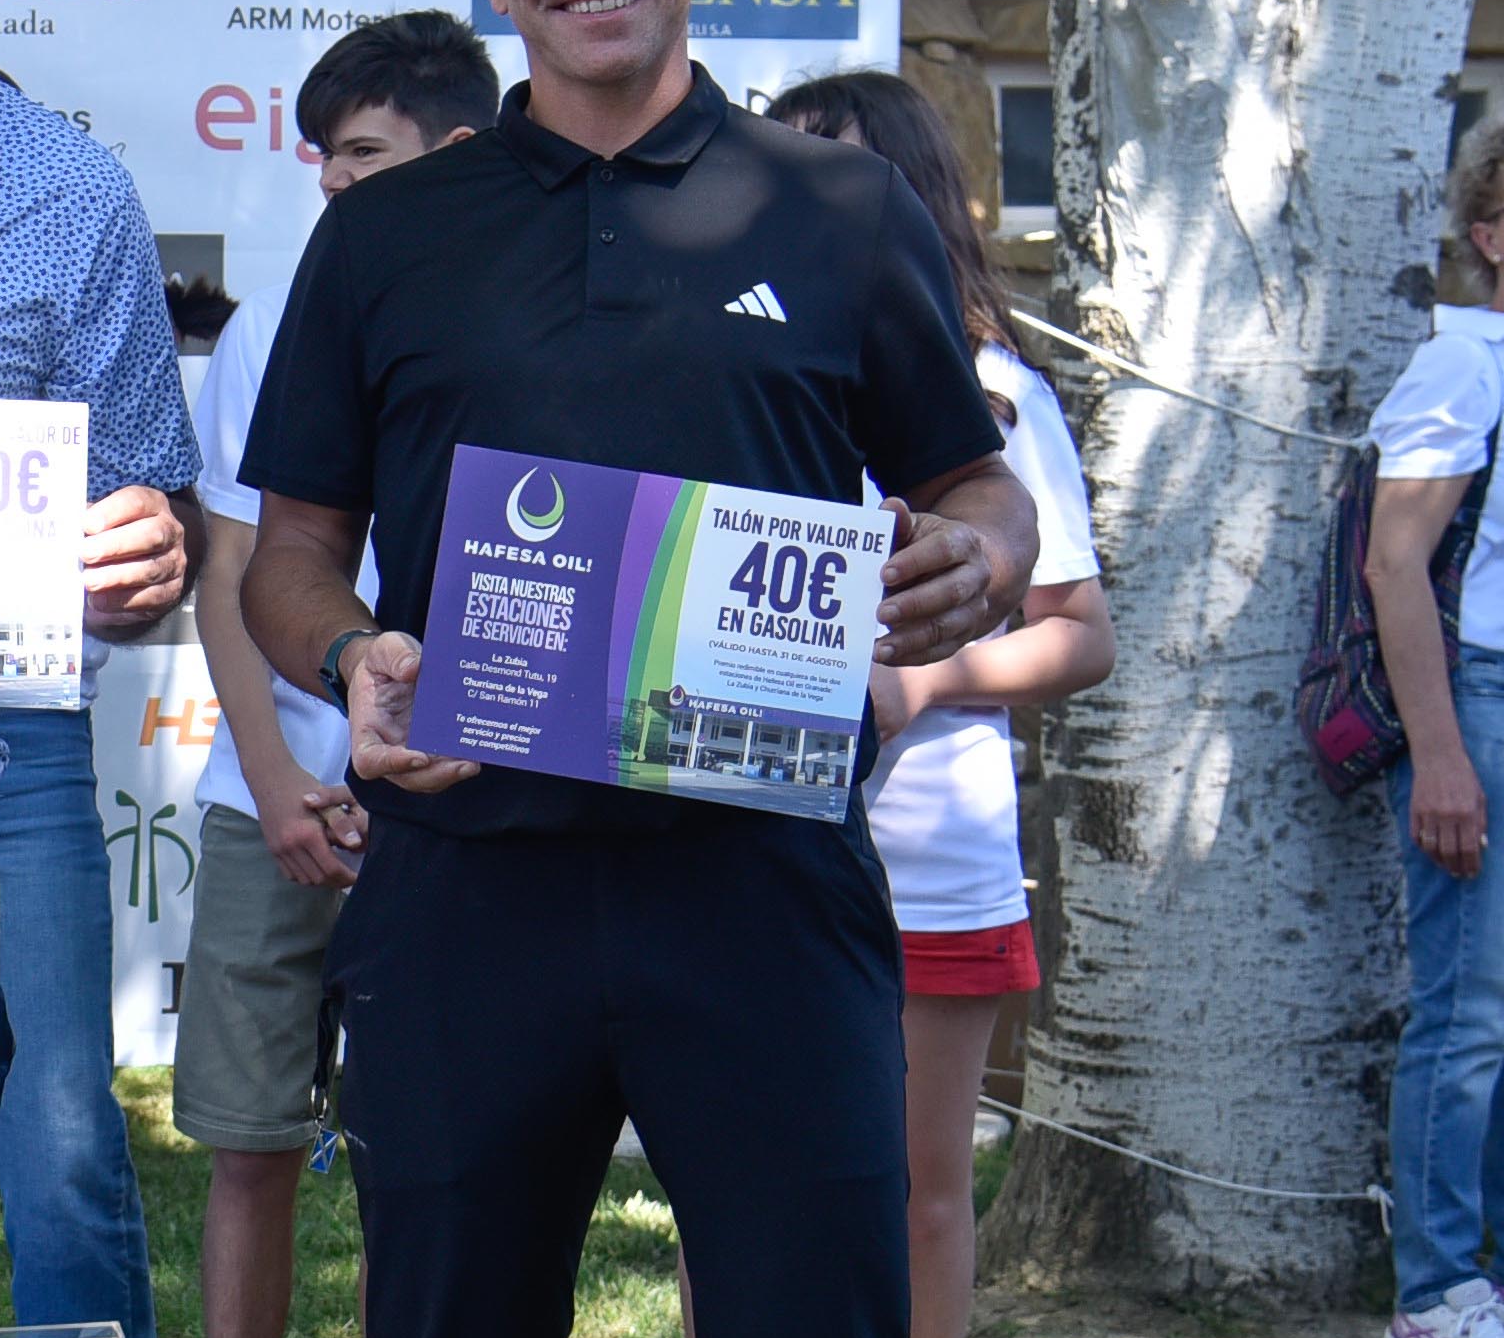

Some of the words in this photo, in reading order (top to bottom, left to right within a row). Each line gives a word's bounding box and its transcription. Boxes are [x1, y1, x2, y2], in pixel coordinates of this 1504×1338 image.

[227, 8, 292, 31] ARM
[710, 503, 765, 535] TALÓN
[767, 516, 802, 541] POR
[804, 522, 858, 550] VALOR
[861, 531, 885, 554] DE
[463, 539, 547, 566] HAFESA
[551, 553, 593, 573] OIL!
[469, 571, 511, 594] VISITA
[509, 577, 576, 605] NUESTRAS
[726, 536, 849, 622] 40€
[465, 590, 574, 631] ESTACIONES
[461, 616, 482, 638] DE
[481, 620, 544, 648] SERVICIO
[544, 630, 569, 652] EN:
[717, 606, 745, 633] EN
[748, 611, 848, 650] GASOLINA
[459, 659, 480, 670] Calle
[481, 663, 522, 677] Desmond
[523, 670, 545, 682] Tutu,
[546, 674, 557, 683] 19
[491, 653, 502, 663] La
[504, 655, 528, 667] Zubia
[462, 676, 503, 691] Churriana
[504, 684, 516, 693] de
[517, 686, 525, 695] la
[526, 687, 548, 700] Vega
[467, 689, 478, 698] C/
[479, 691, 496, 701] San
[497, 694, 527, 706] Ramón
[528, 699, 539, 708] 11
